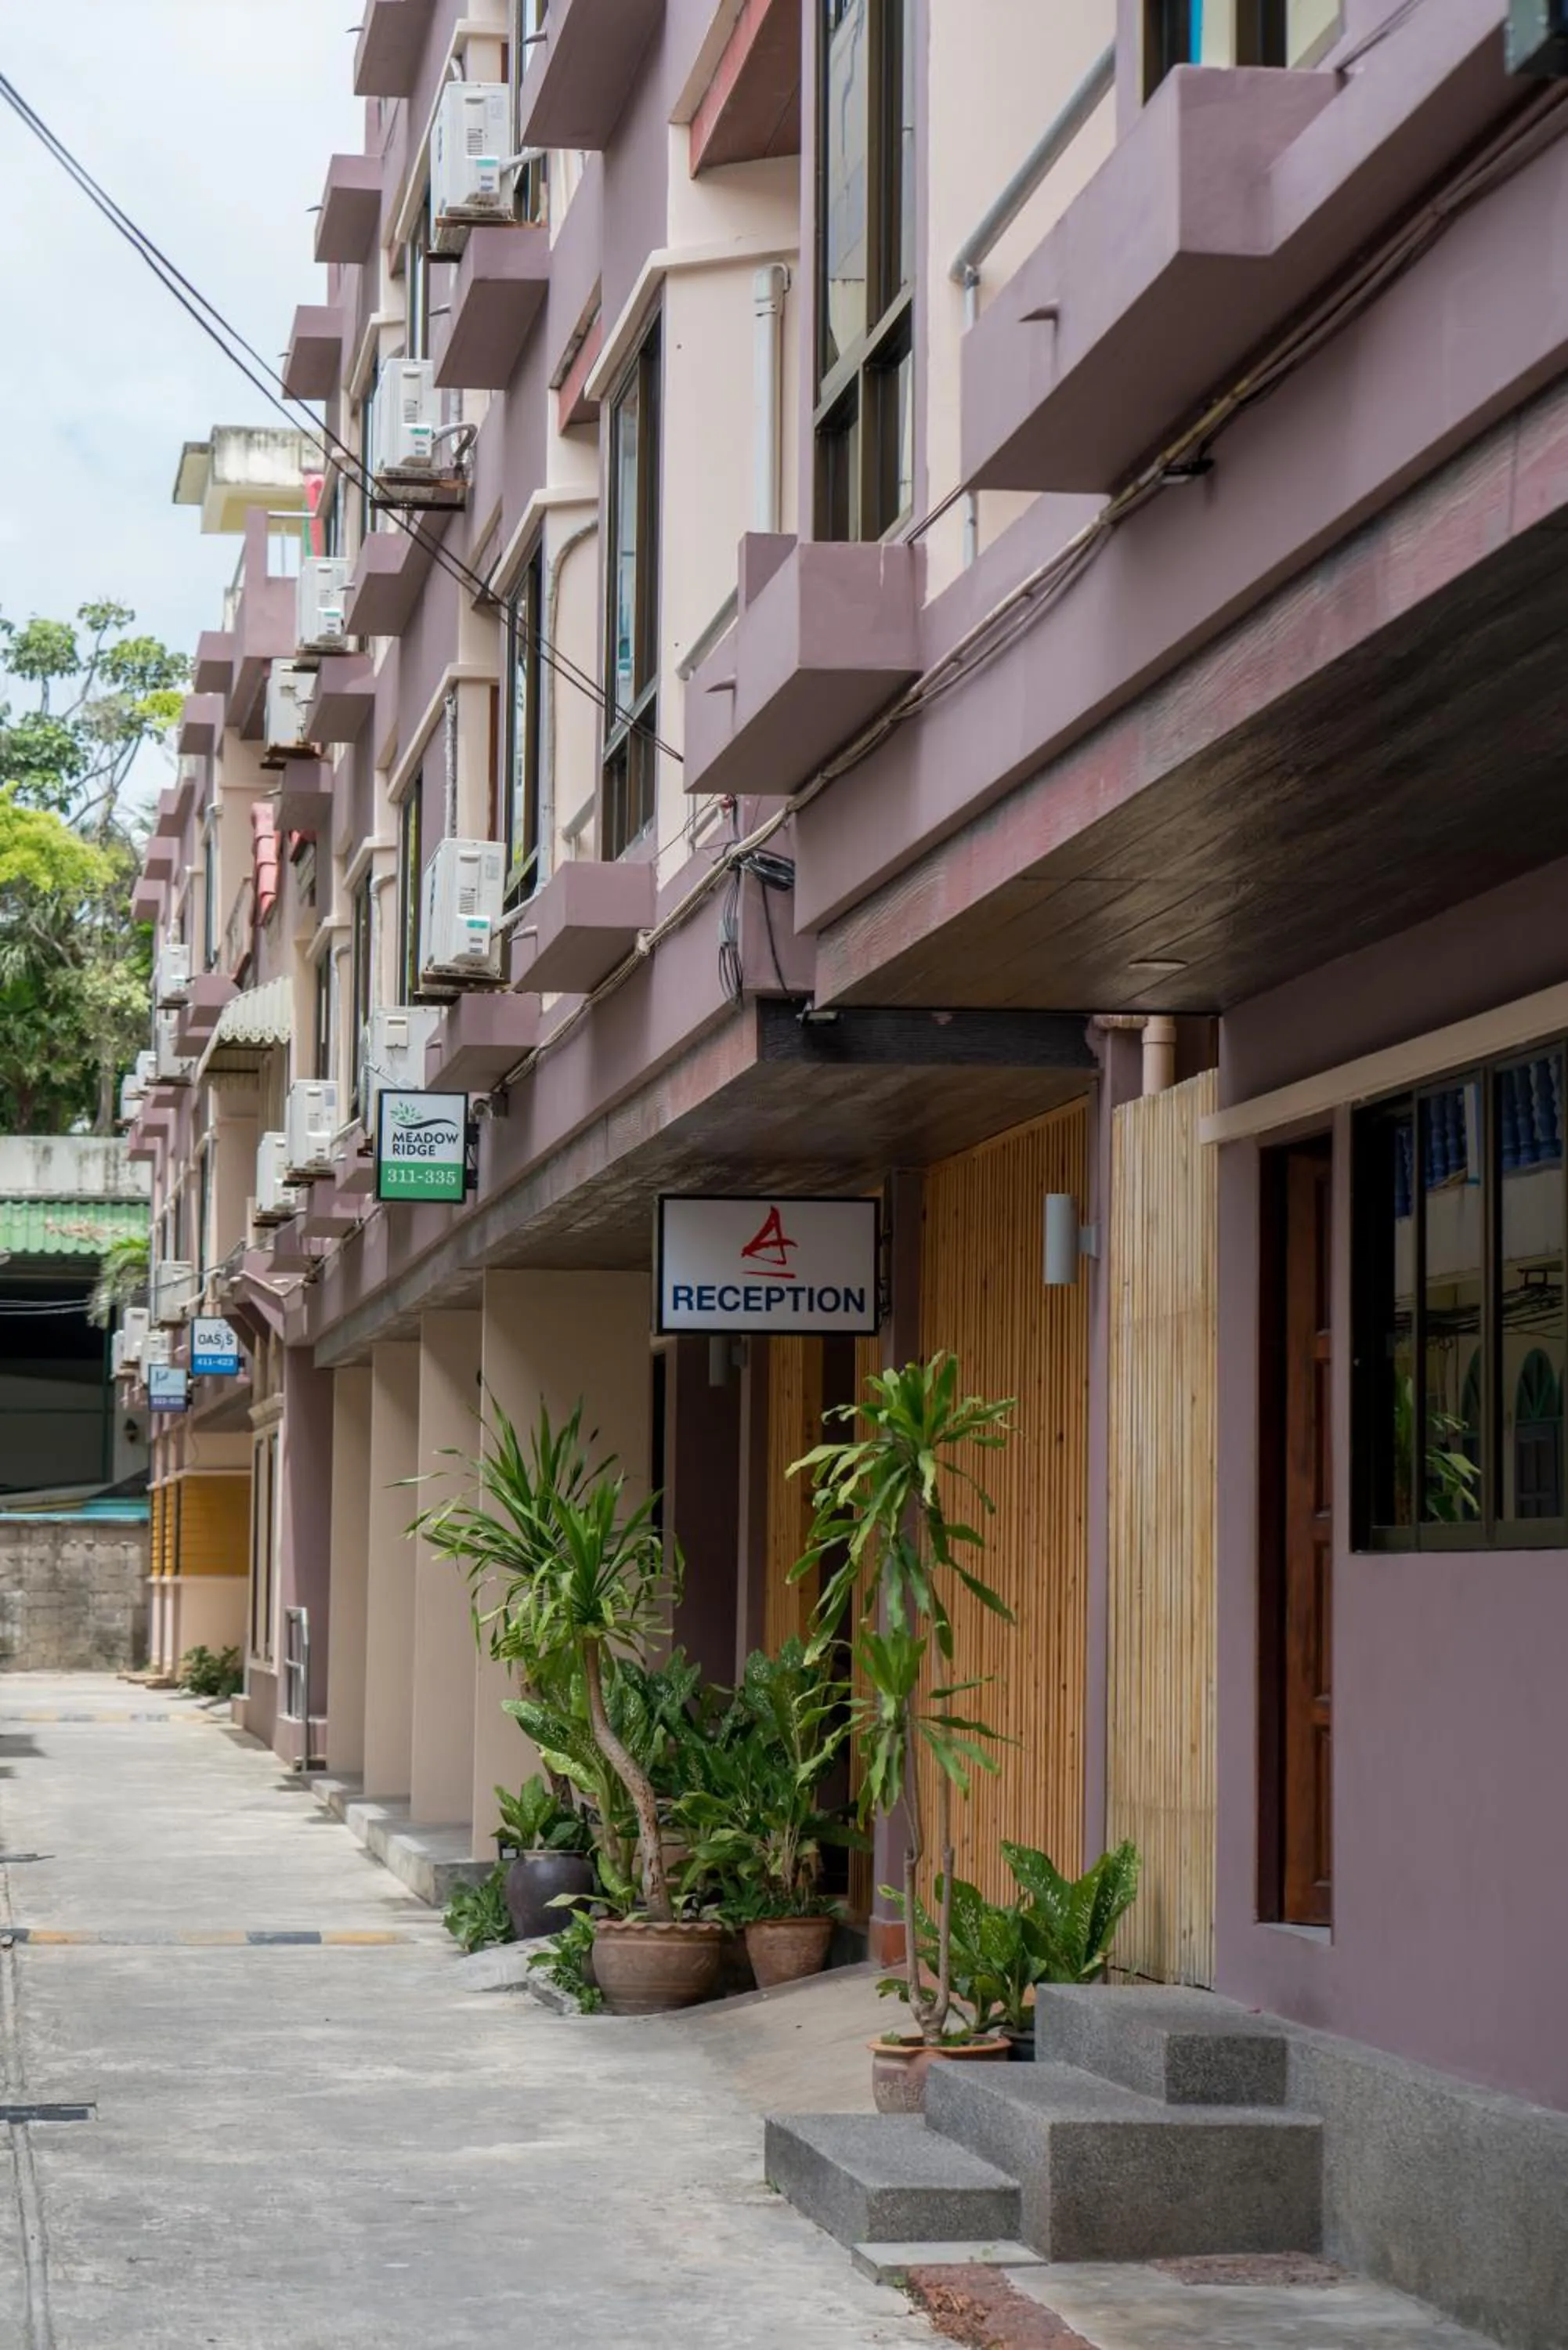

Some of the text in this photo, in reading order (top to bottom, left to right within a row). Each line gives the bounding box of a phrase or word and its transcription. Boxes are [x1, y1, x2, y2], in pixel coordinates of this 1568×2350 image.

[392, 1132, 458, 1144] MEADOW
[392, 1144, 436, 1155] RIDGE
[387, 1168, 457, 1185] 311-335
[672, 1285, 865, 1314] RECEPTION
